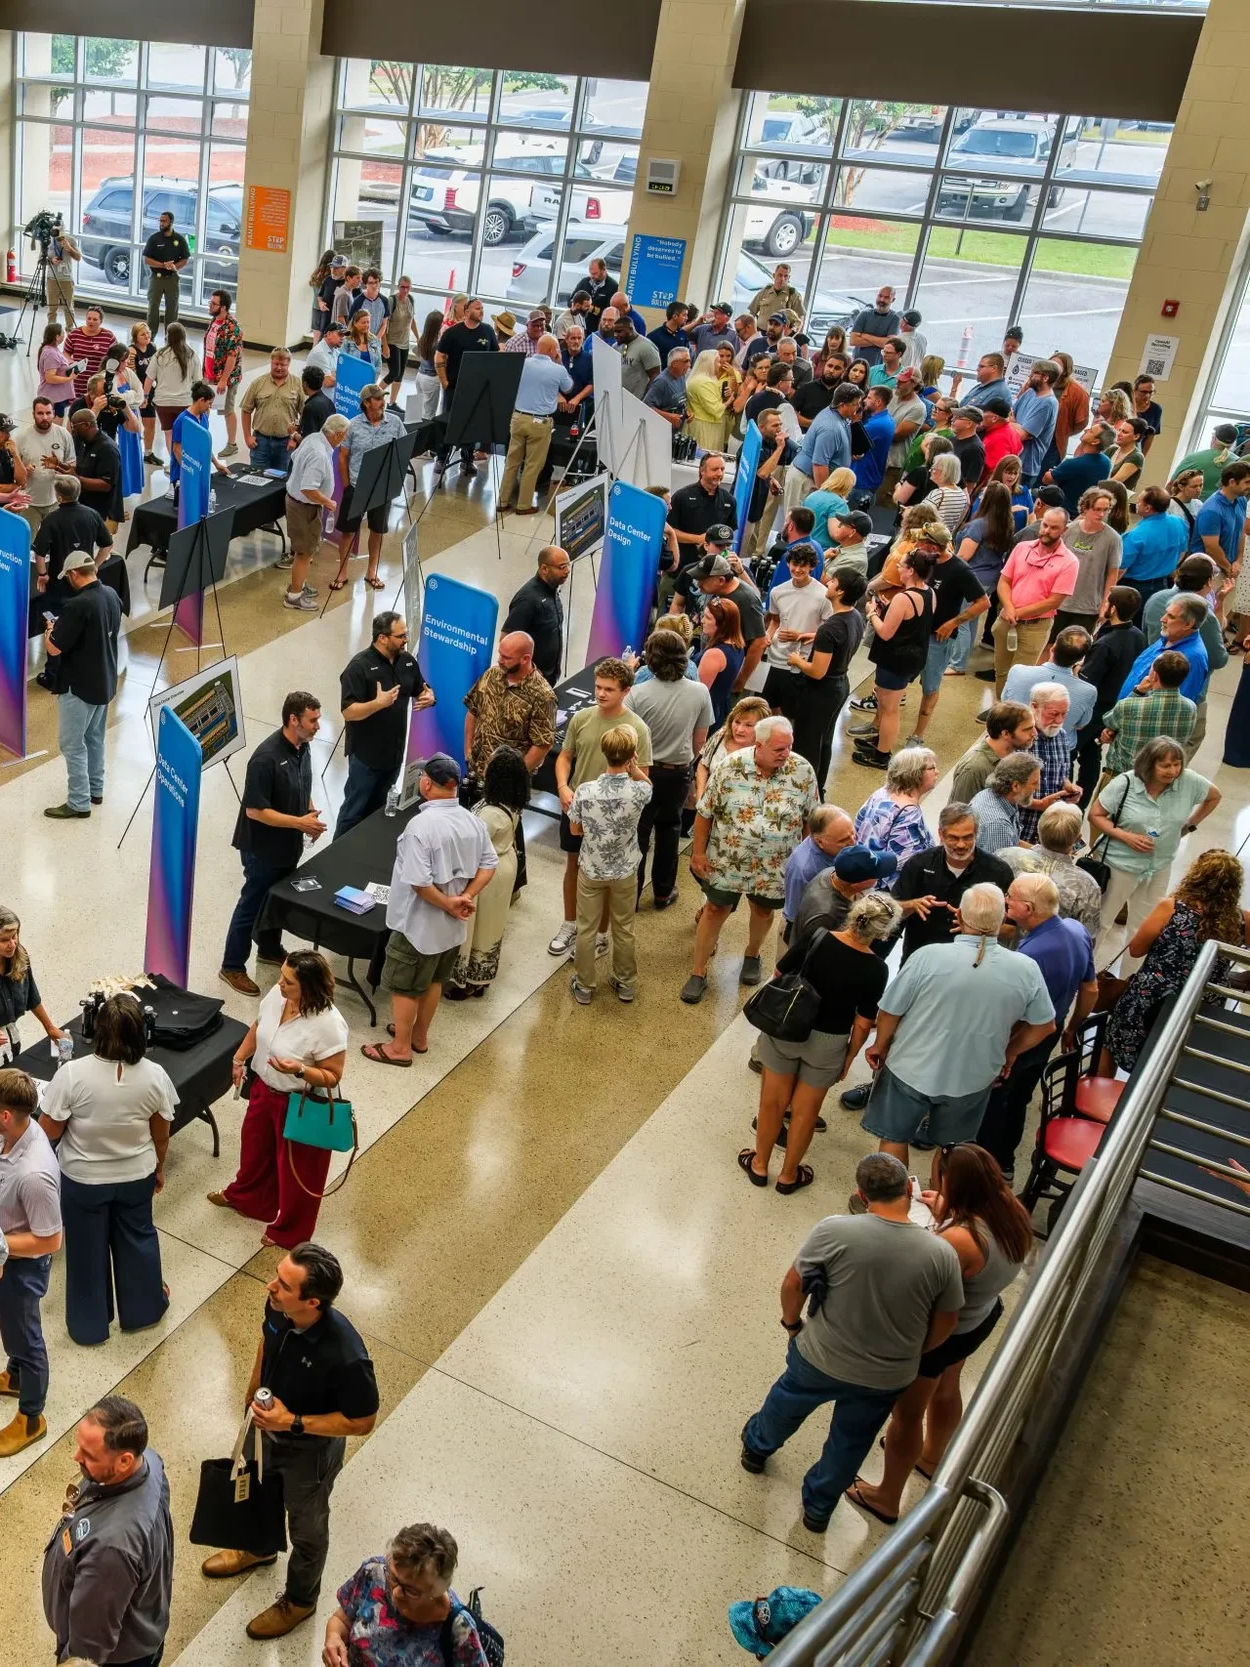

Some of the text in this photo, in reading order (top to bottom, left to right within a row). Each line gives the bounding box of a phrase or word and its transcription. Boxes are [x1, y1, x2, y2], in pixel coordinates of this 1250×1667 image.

[543, 196, 561, 205] RA
[630, 236, 642, 275] BULLYING
[607, 528, 632, 546] Design
[610, 516, 651, 542] Data Center
[423, 626, 477, 656] Stewardship
[425, 613, 488, 647] Environmental
[157, 768, 185, 808] Operations
[158, 753, 189, 795] Data Center
